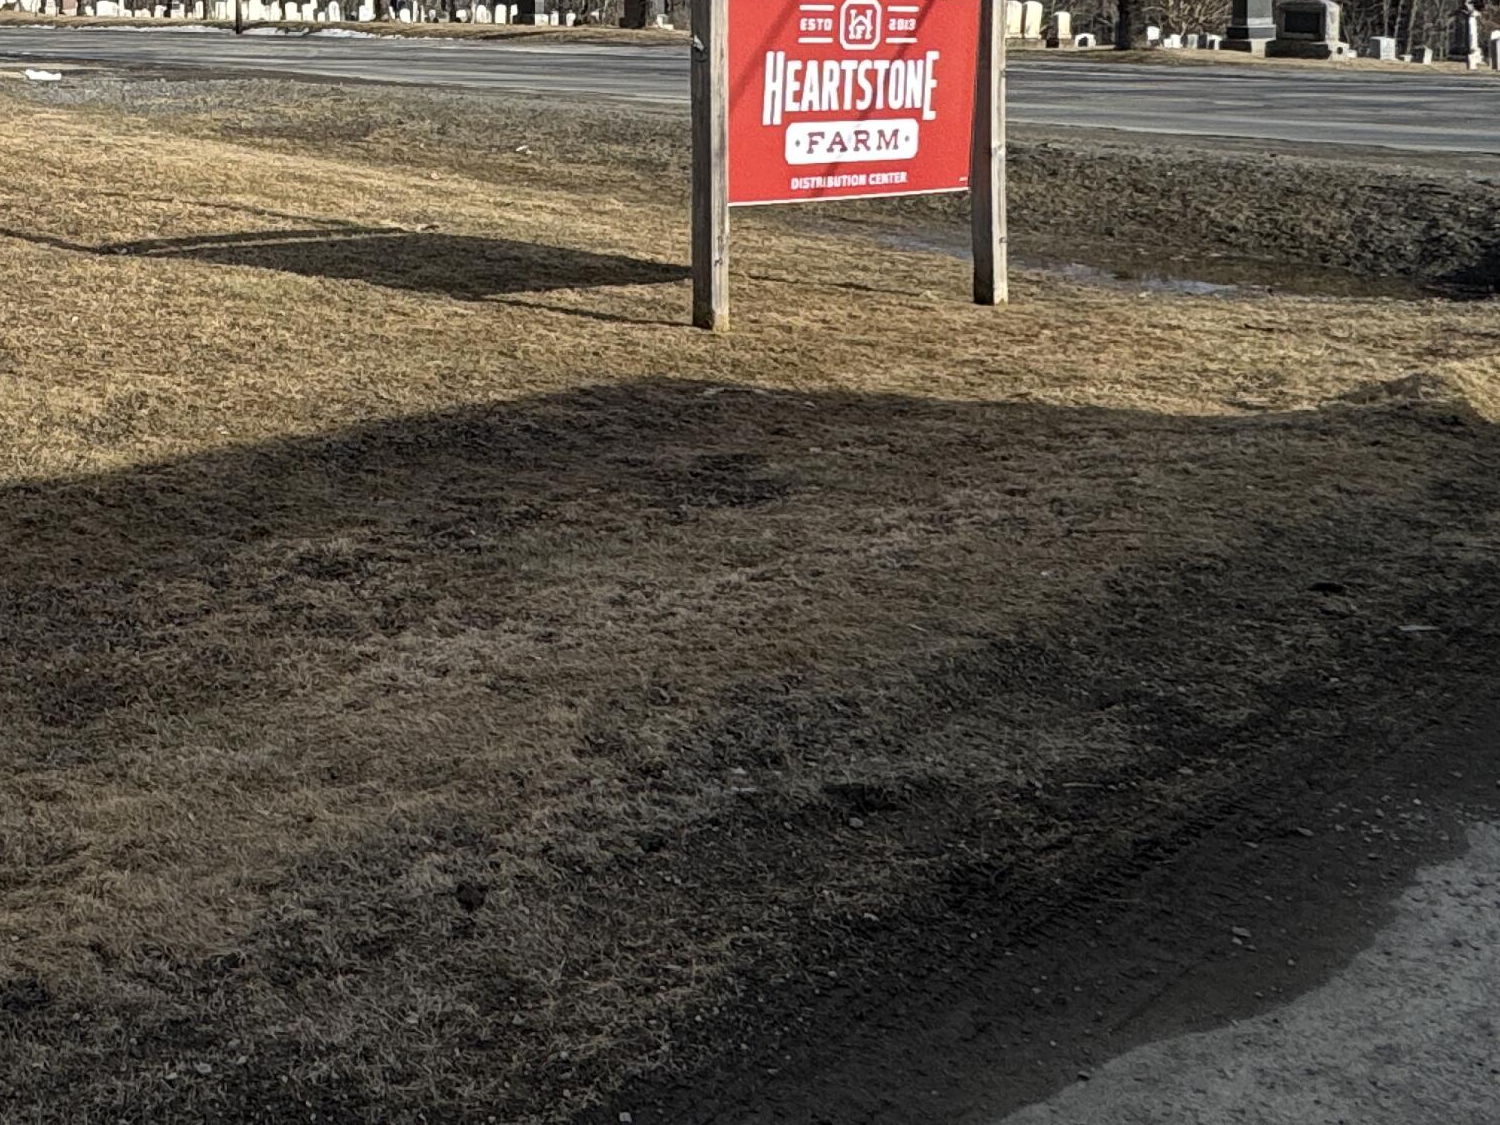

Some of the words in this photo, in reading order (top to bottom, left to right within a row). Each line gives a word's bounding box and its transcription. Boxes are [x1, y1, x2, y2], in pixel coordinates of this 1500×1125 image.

[888, 18, 917, 31] 2013
[762, 51, 940, 125] HEARTSTONE
[806, 129, 900, 154] FARM
[790, 174, 867, 190] DISTRIBUTION
[868, 172, 908, 186] CENTER
